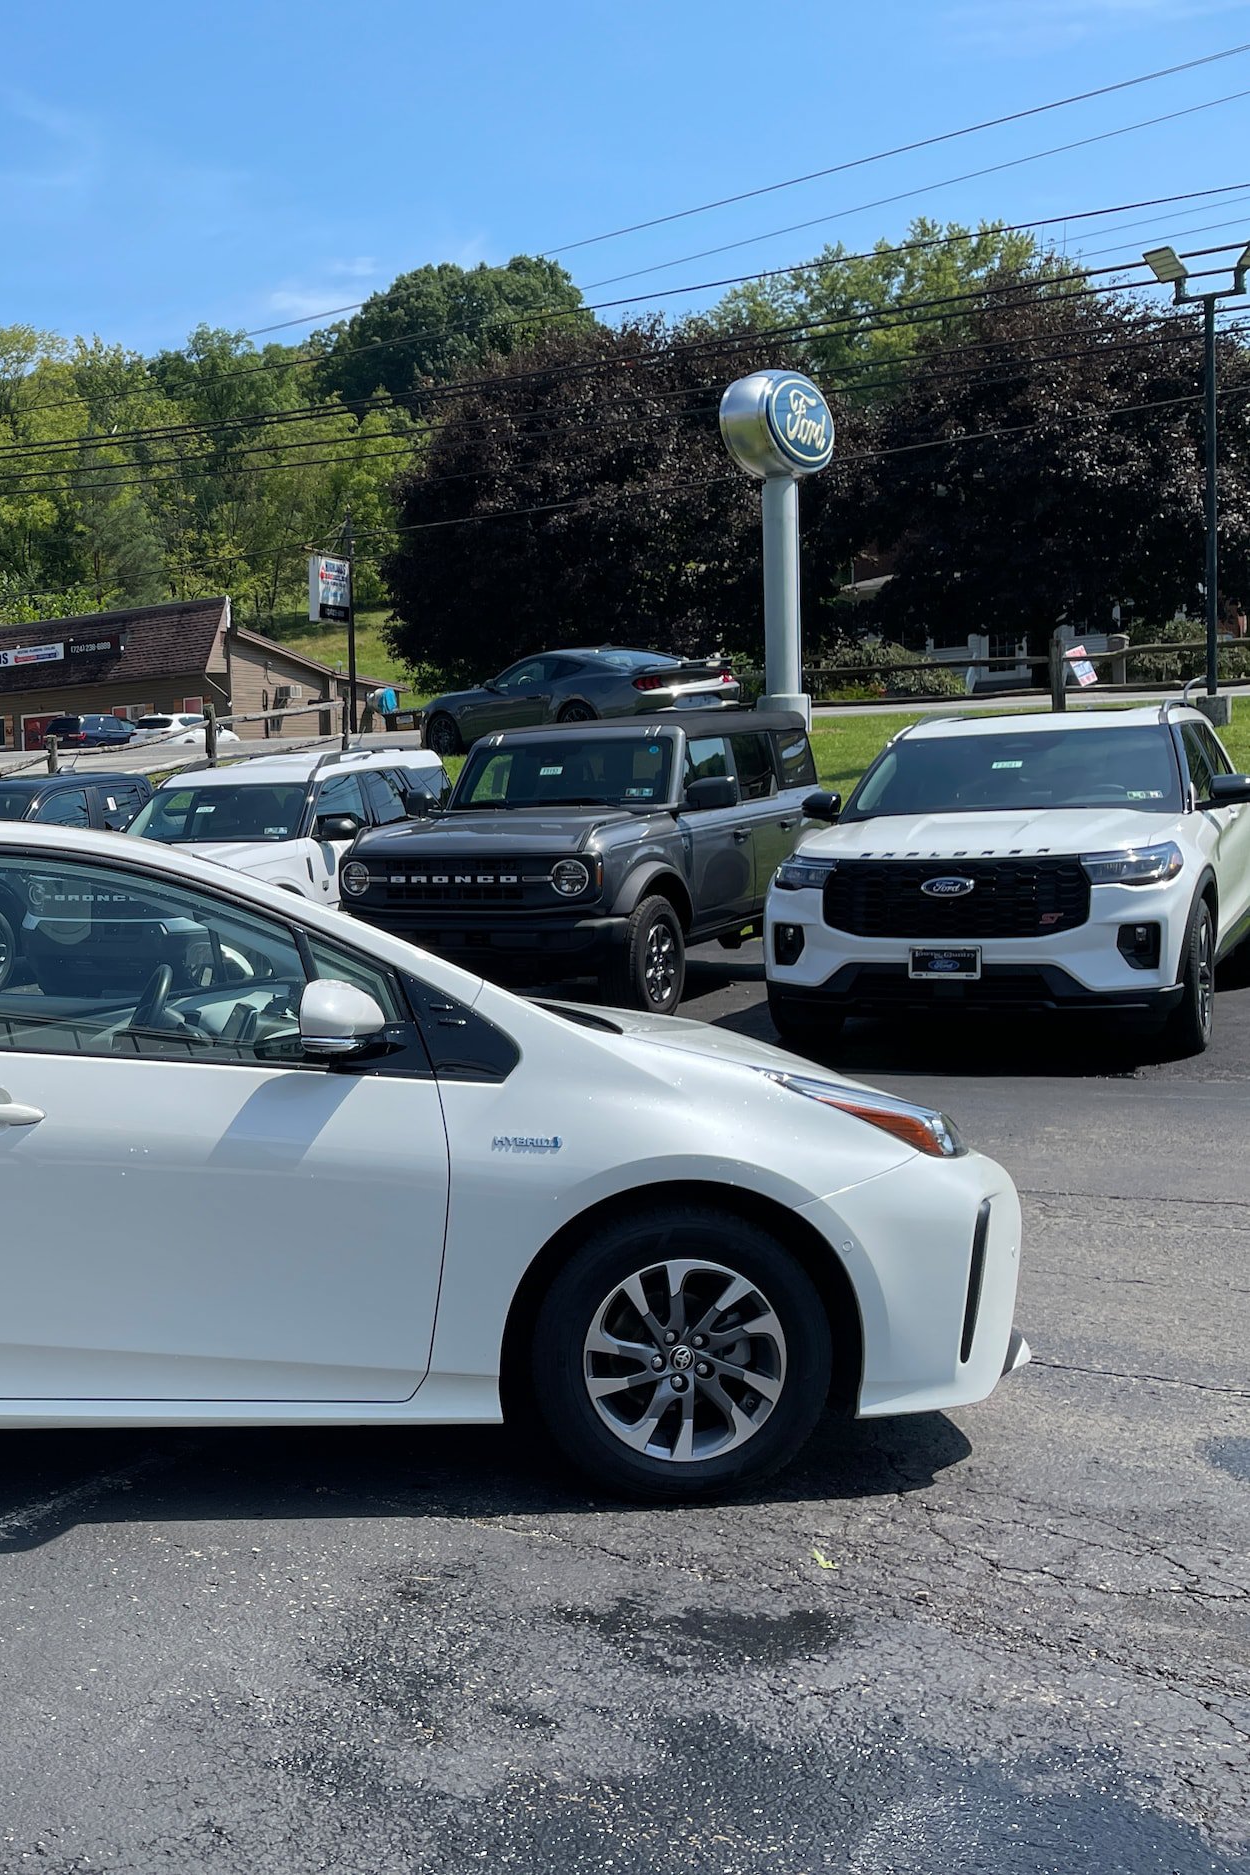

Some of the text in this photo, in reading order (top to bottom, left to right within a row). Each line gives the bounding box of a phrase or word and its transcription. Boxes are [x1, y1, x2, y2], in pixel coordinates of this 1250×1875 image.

[787, 389, 826, 451] Ford
[860, 848, 1050, 858] EXPLORER
[390, 875, 517, 883] BRONCO
[932, 880, 960, 892] Ford
[1039, 912, 1064, 925] ST
[933, 960, 954, 969] Ford
[492, 1136, 552, 1149] HYBRID
